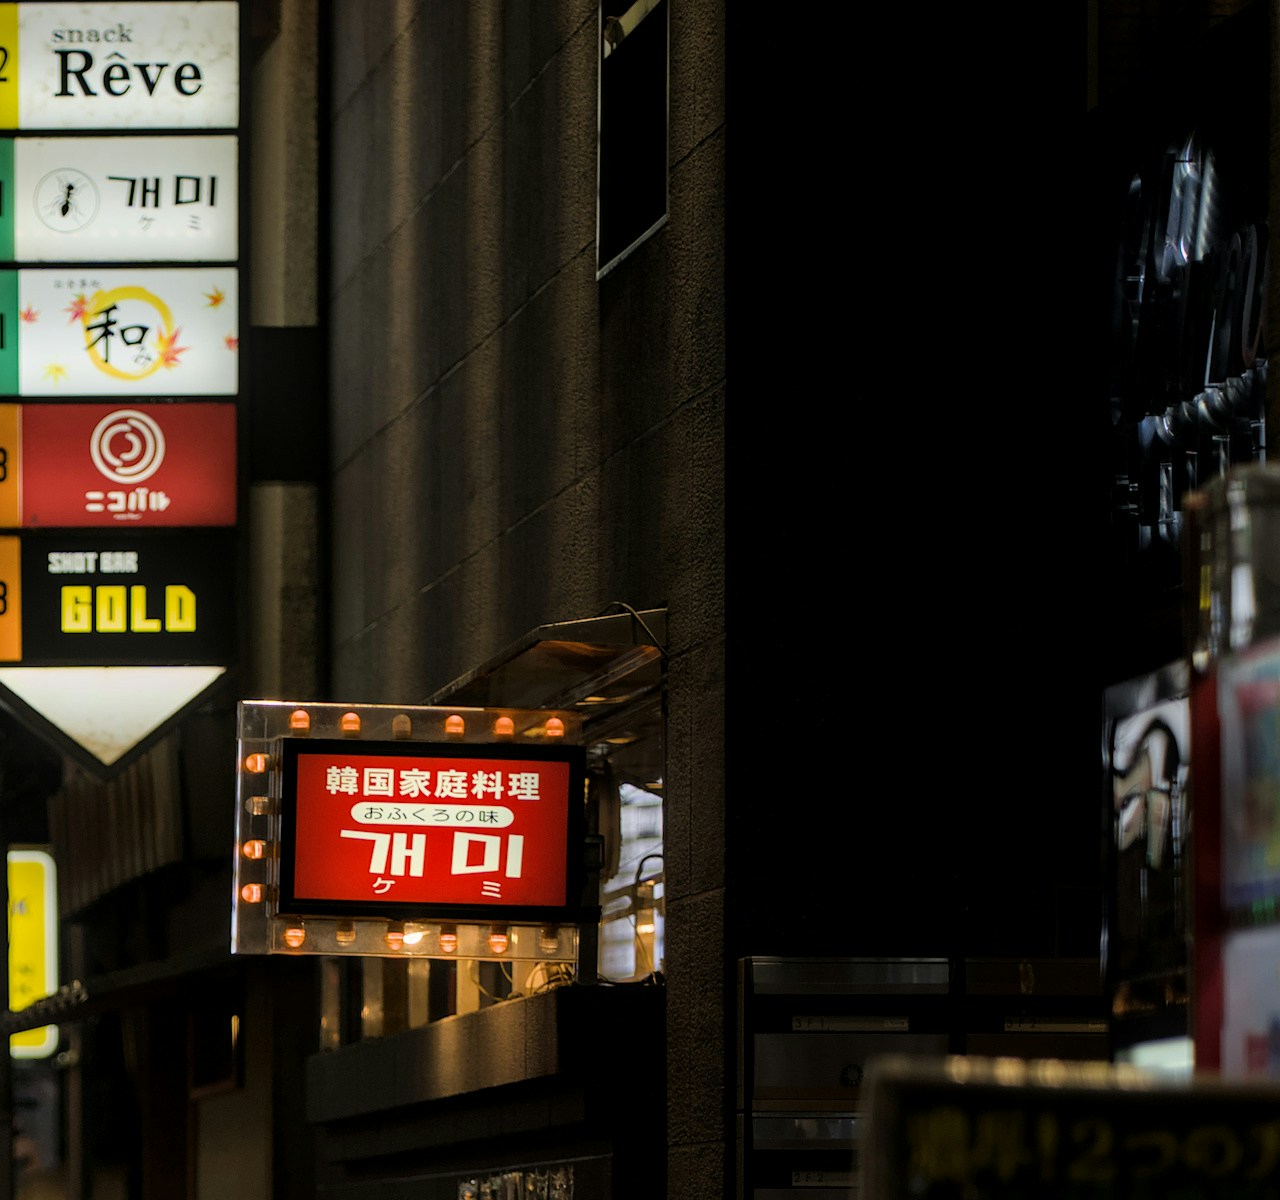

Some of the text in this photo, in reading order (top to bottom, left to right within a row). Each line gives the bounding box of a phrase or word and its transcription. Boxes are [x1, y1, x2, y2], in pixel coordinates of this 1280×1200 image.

[51, 23, 135, 44] snack
[53, 50, 203, 97] Rêve
[107, 175, 217, 207] 개미
[47, 551, 139, 574] SHOT BAR
[60, 584, 197, 633] GOLD
[325, 765, 542, 801] 韓国家庭料理
[362, 806, 500, 825] おふくろの味
[339, 829, 525, 879] 개미
